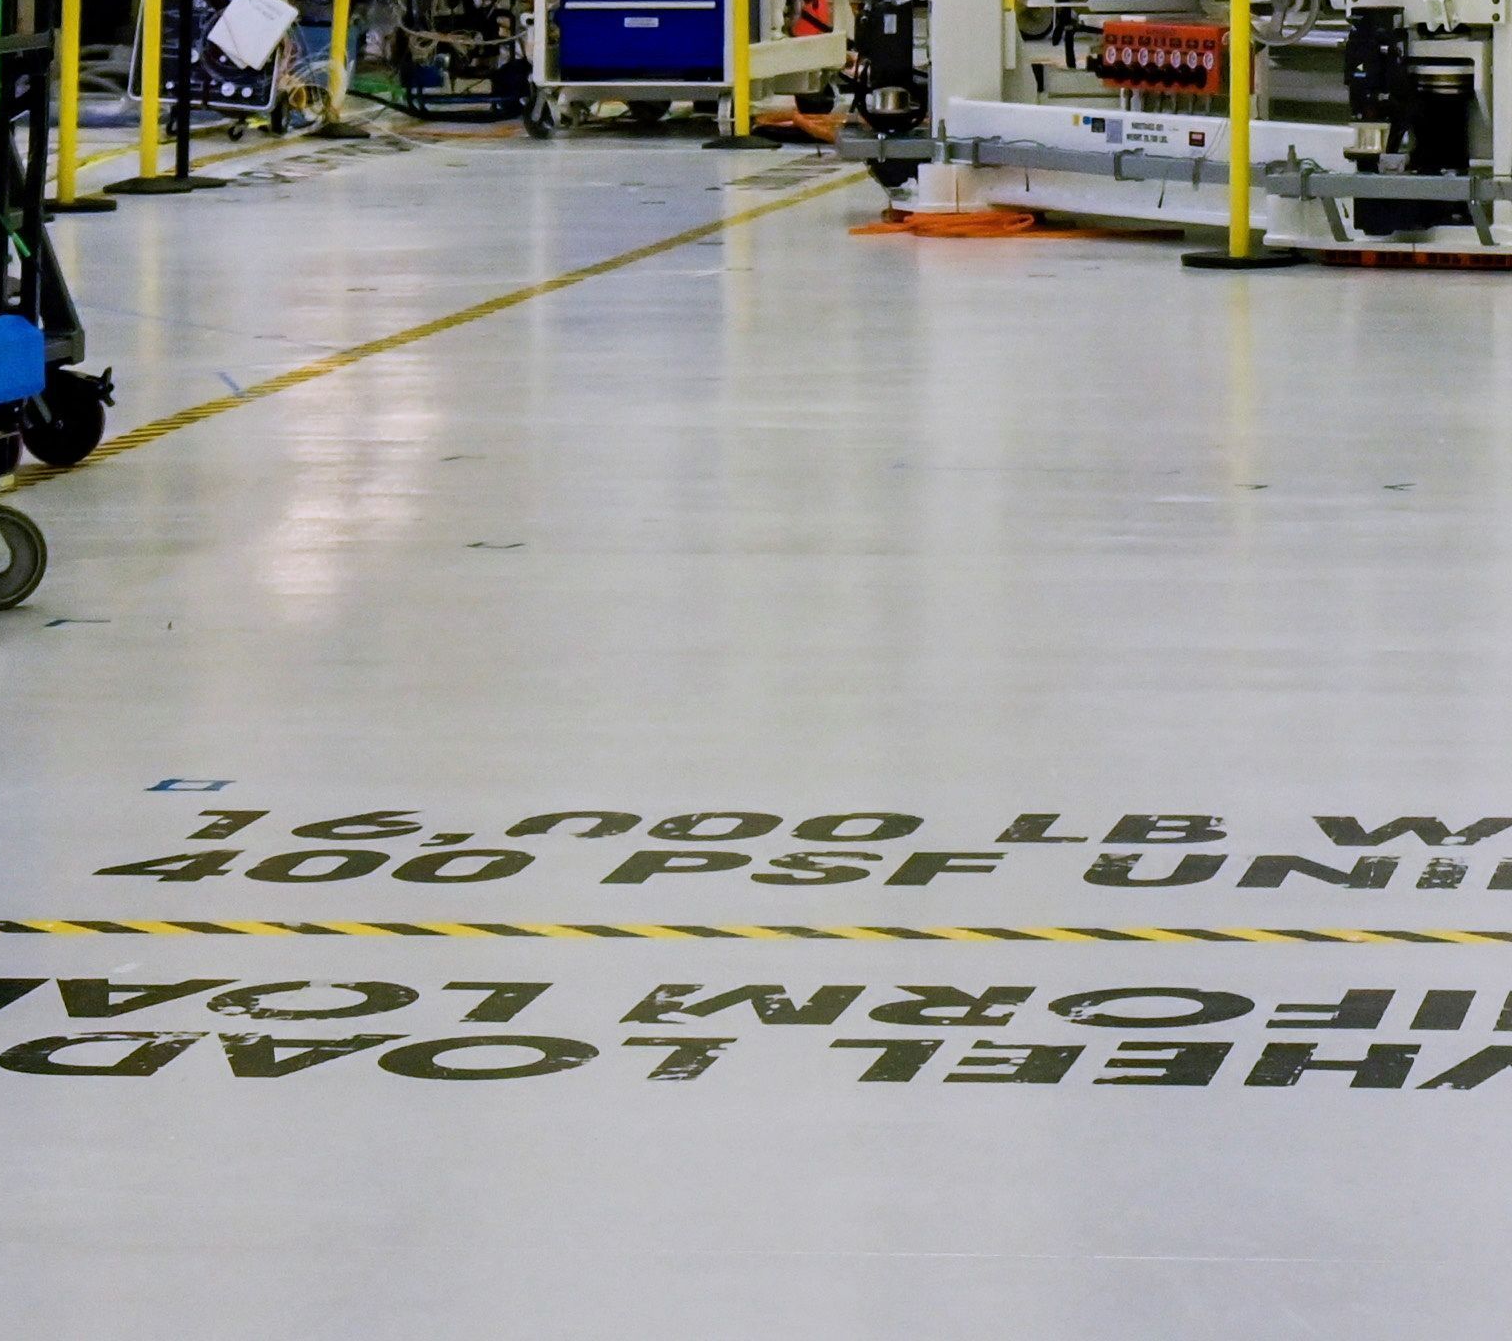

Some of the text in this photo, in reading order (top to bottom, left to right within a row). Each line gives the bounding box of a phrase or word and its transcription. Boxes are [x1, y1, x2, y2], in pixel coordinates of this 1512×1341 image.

[186, 809, 925, 848] 16,000
[995, 814, 1228, 844] LB
[92, 849, 536, 883] 400
[599, 850, 1008, 886] PSF
